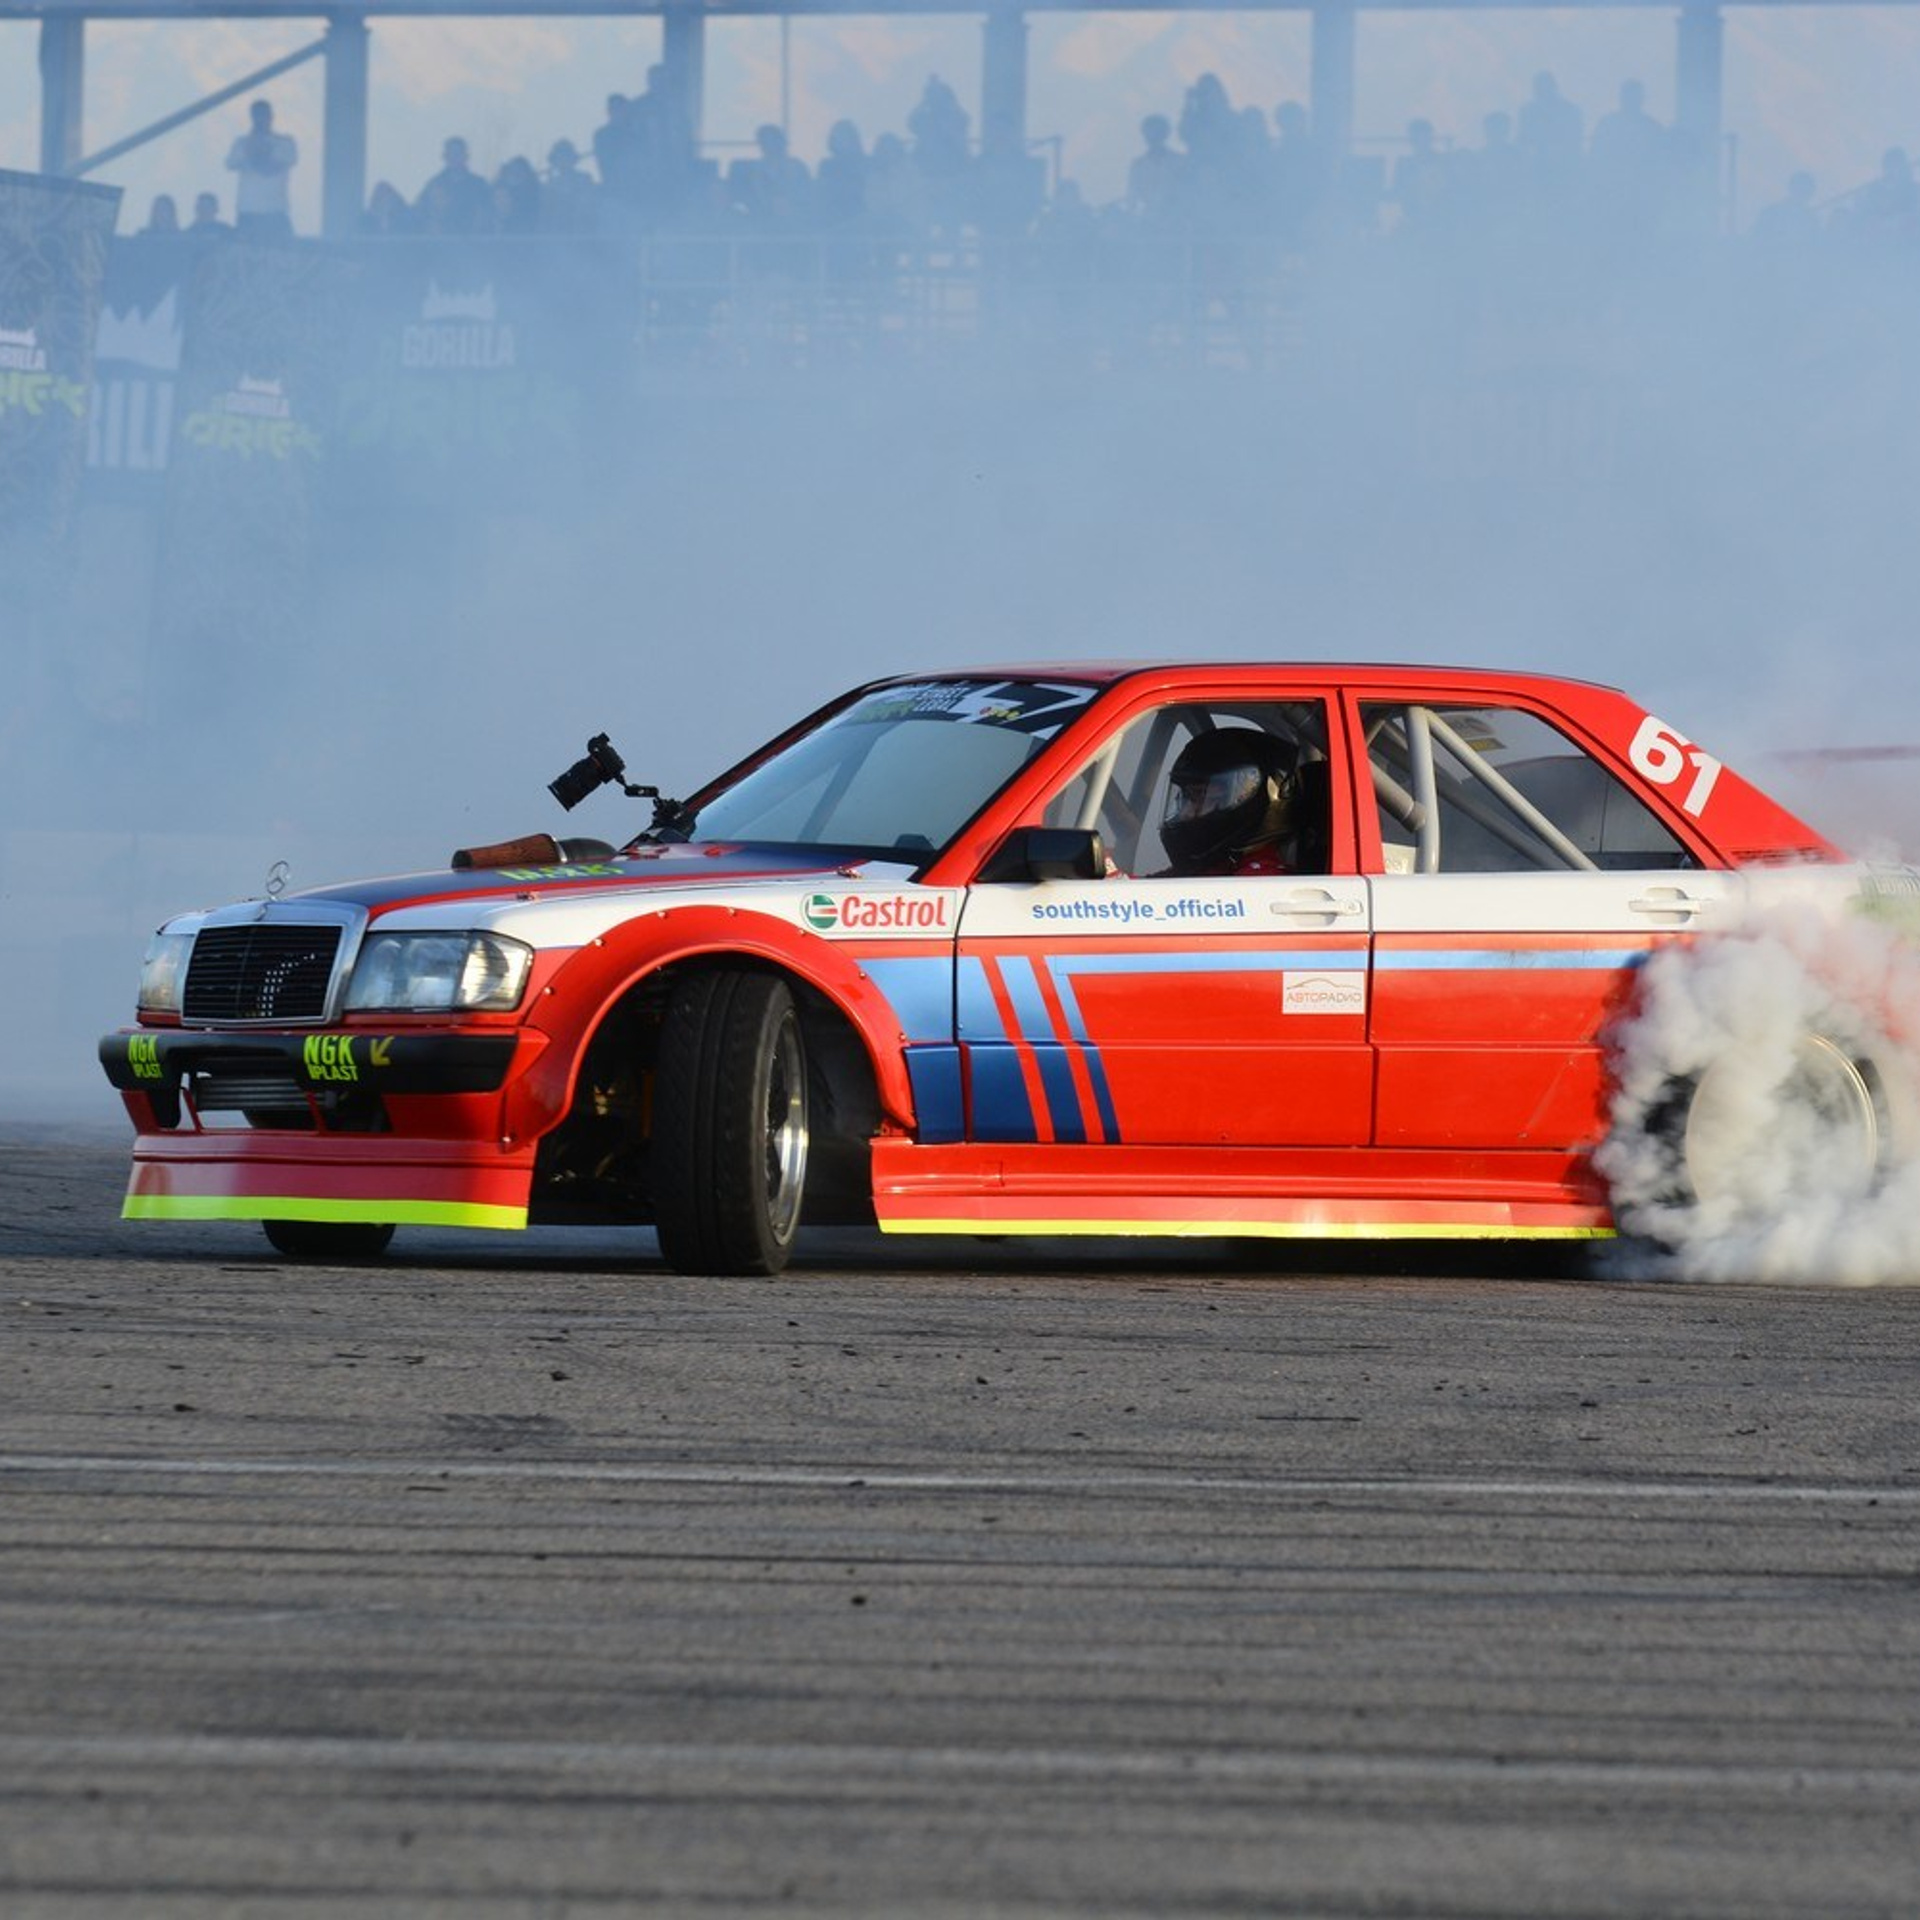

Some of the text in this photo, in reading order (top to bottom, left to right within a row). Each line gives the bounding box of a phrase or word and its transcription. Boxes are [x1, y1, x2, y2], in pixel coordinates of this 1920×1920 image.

[1628, 715, 1722, 817] 61
[841, 896, 946, 927] Castrol
[1032, 899, 1245, 922] southstyle_official
[128, 1034, 158, 1062] NGK
[303, 1035, 357, 1065] NGK
